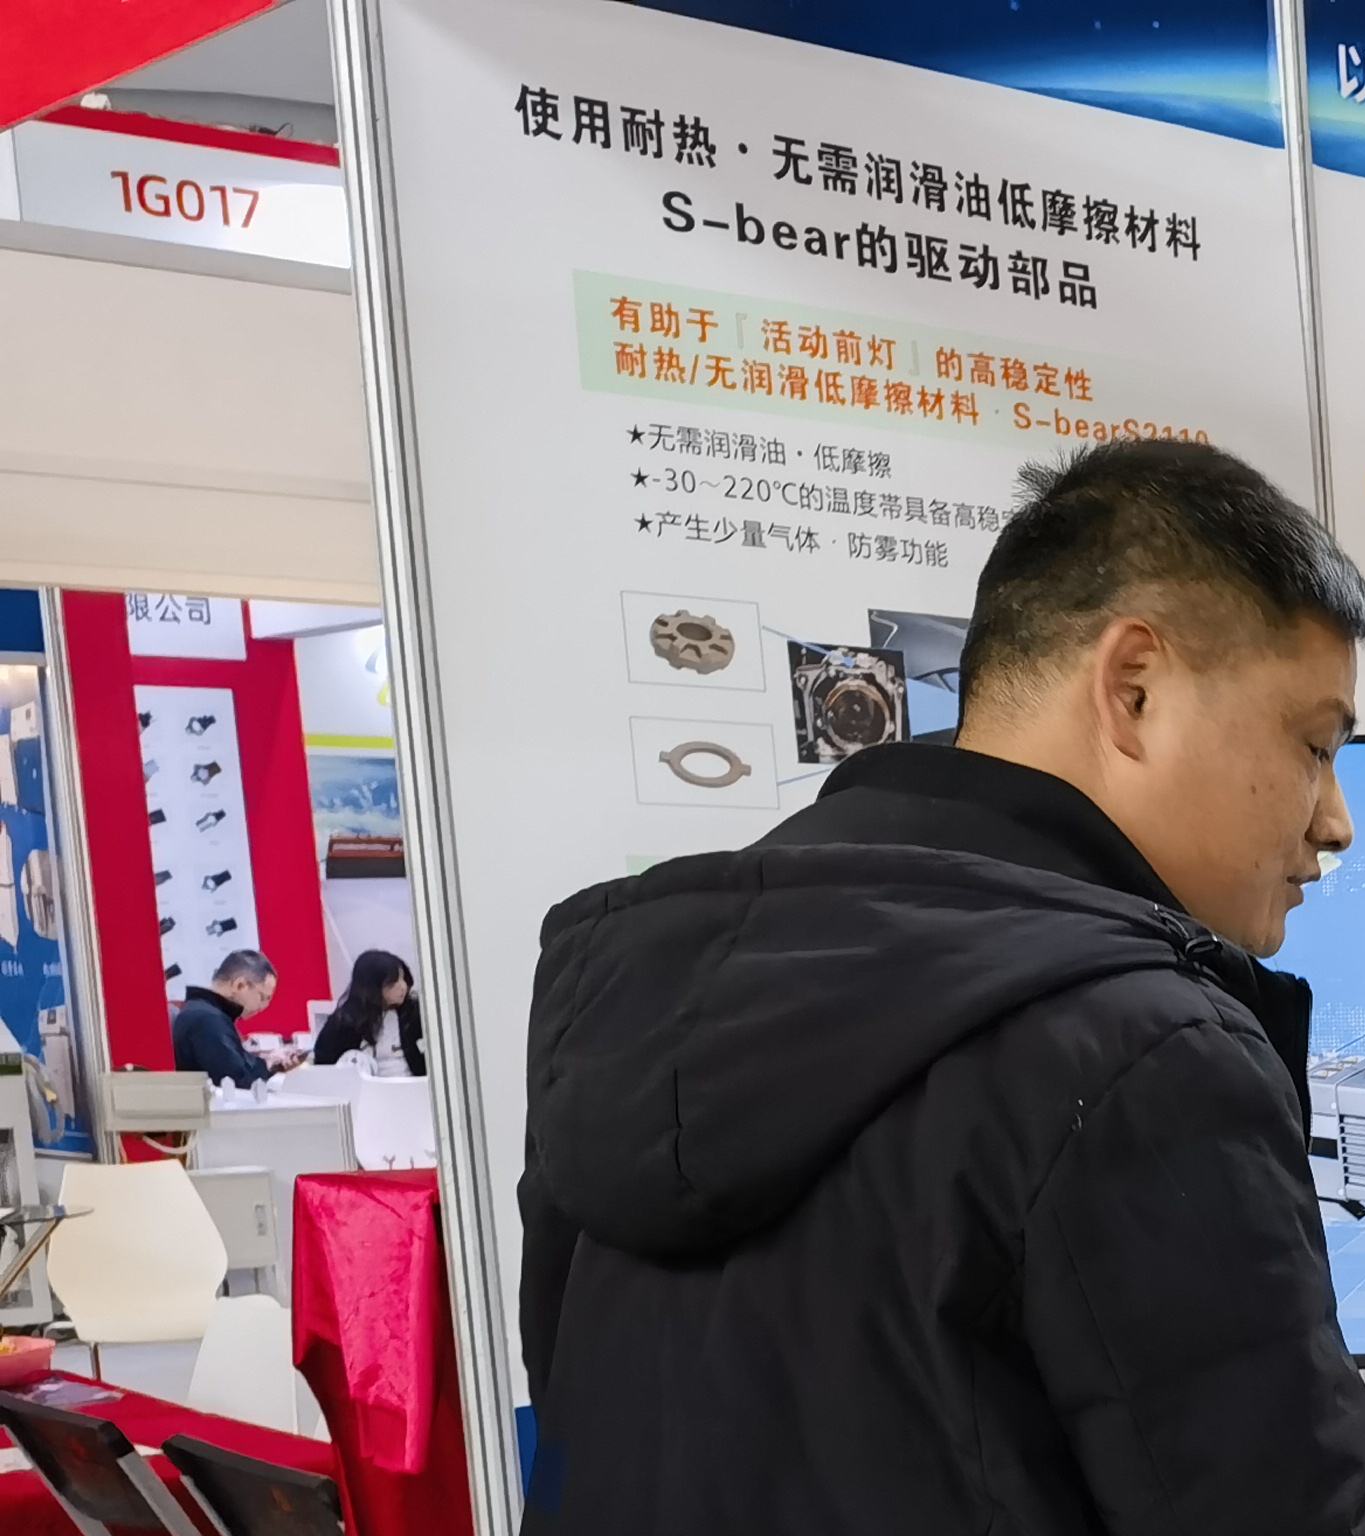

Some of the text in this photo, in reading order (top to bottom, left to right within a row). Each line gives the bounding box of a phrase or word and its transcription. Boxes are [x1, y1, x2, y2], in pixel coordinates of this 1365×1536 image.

[110, 170, 260, 230] 1G017
[661, 192, 1098, 309] S-bear的驱动部品
[129, 593, 211, 625] 限公司
